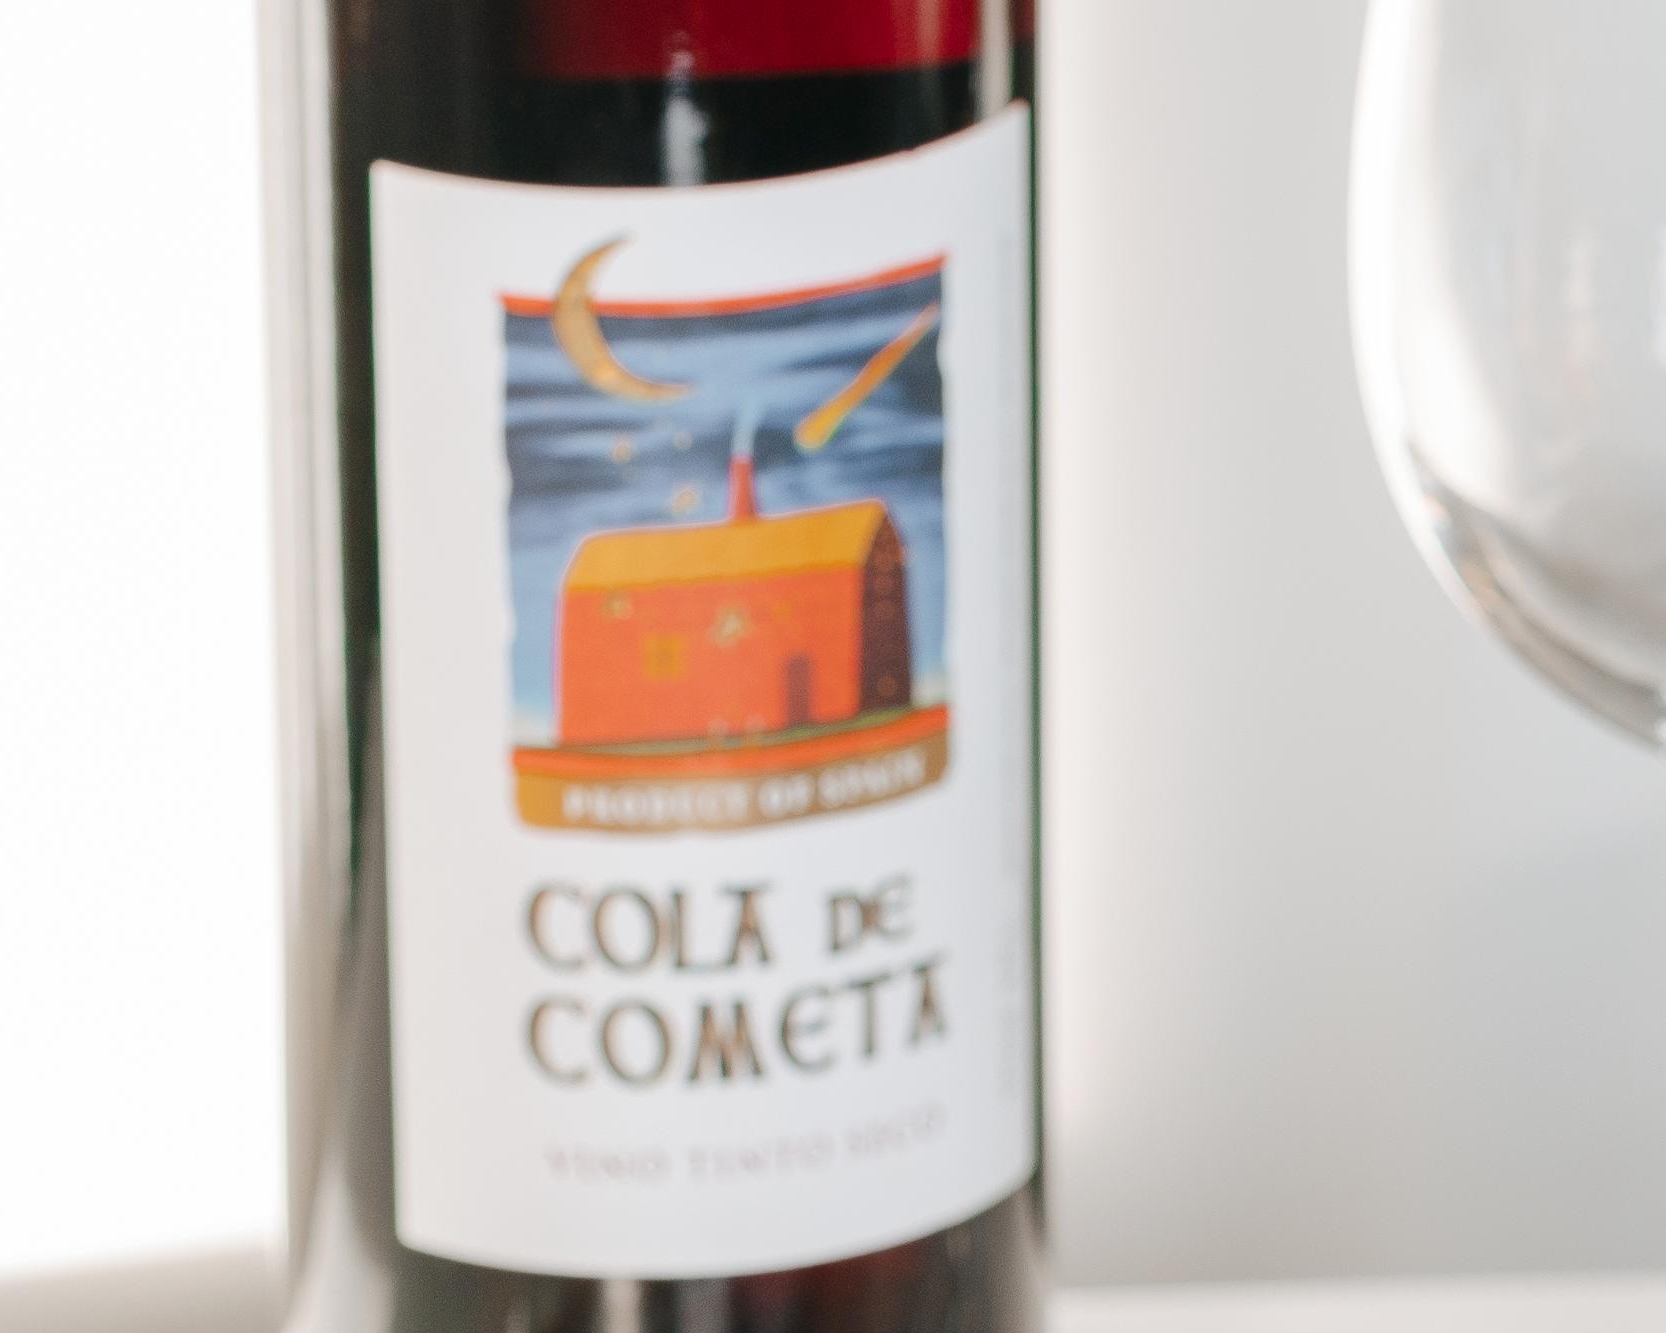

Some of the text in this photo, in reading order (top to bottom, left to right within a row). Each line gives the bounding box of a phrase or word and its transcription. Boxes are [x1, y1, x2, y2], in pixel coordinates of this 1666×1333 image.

[562, 782, 751, 824] PRODUCT
[757, 774, 816, 818] OF
[525, 872, 914, 974] COLA DE
[525, 951, 951, 1087] COMETA
